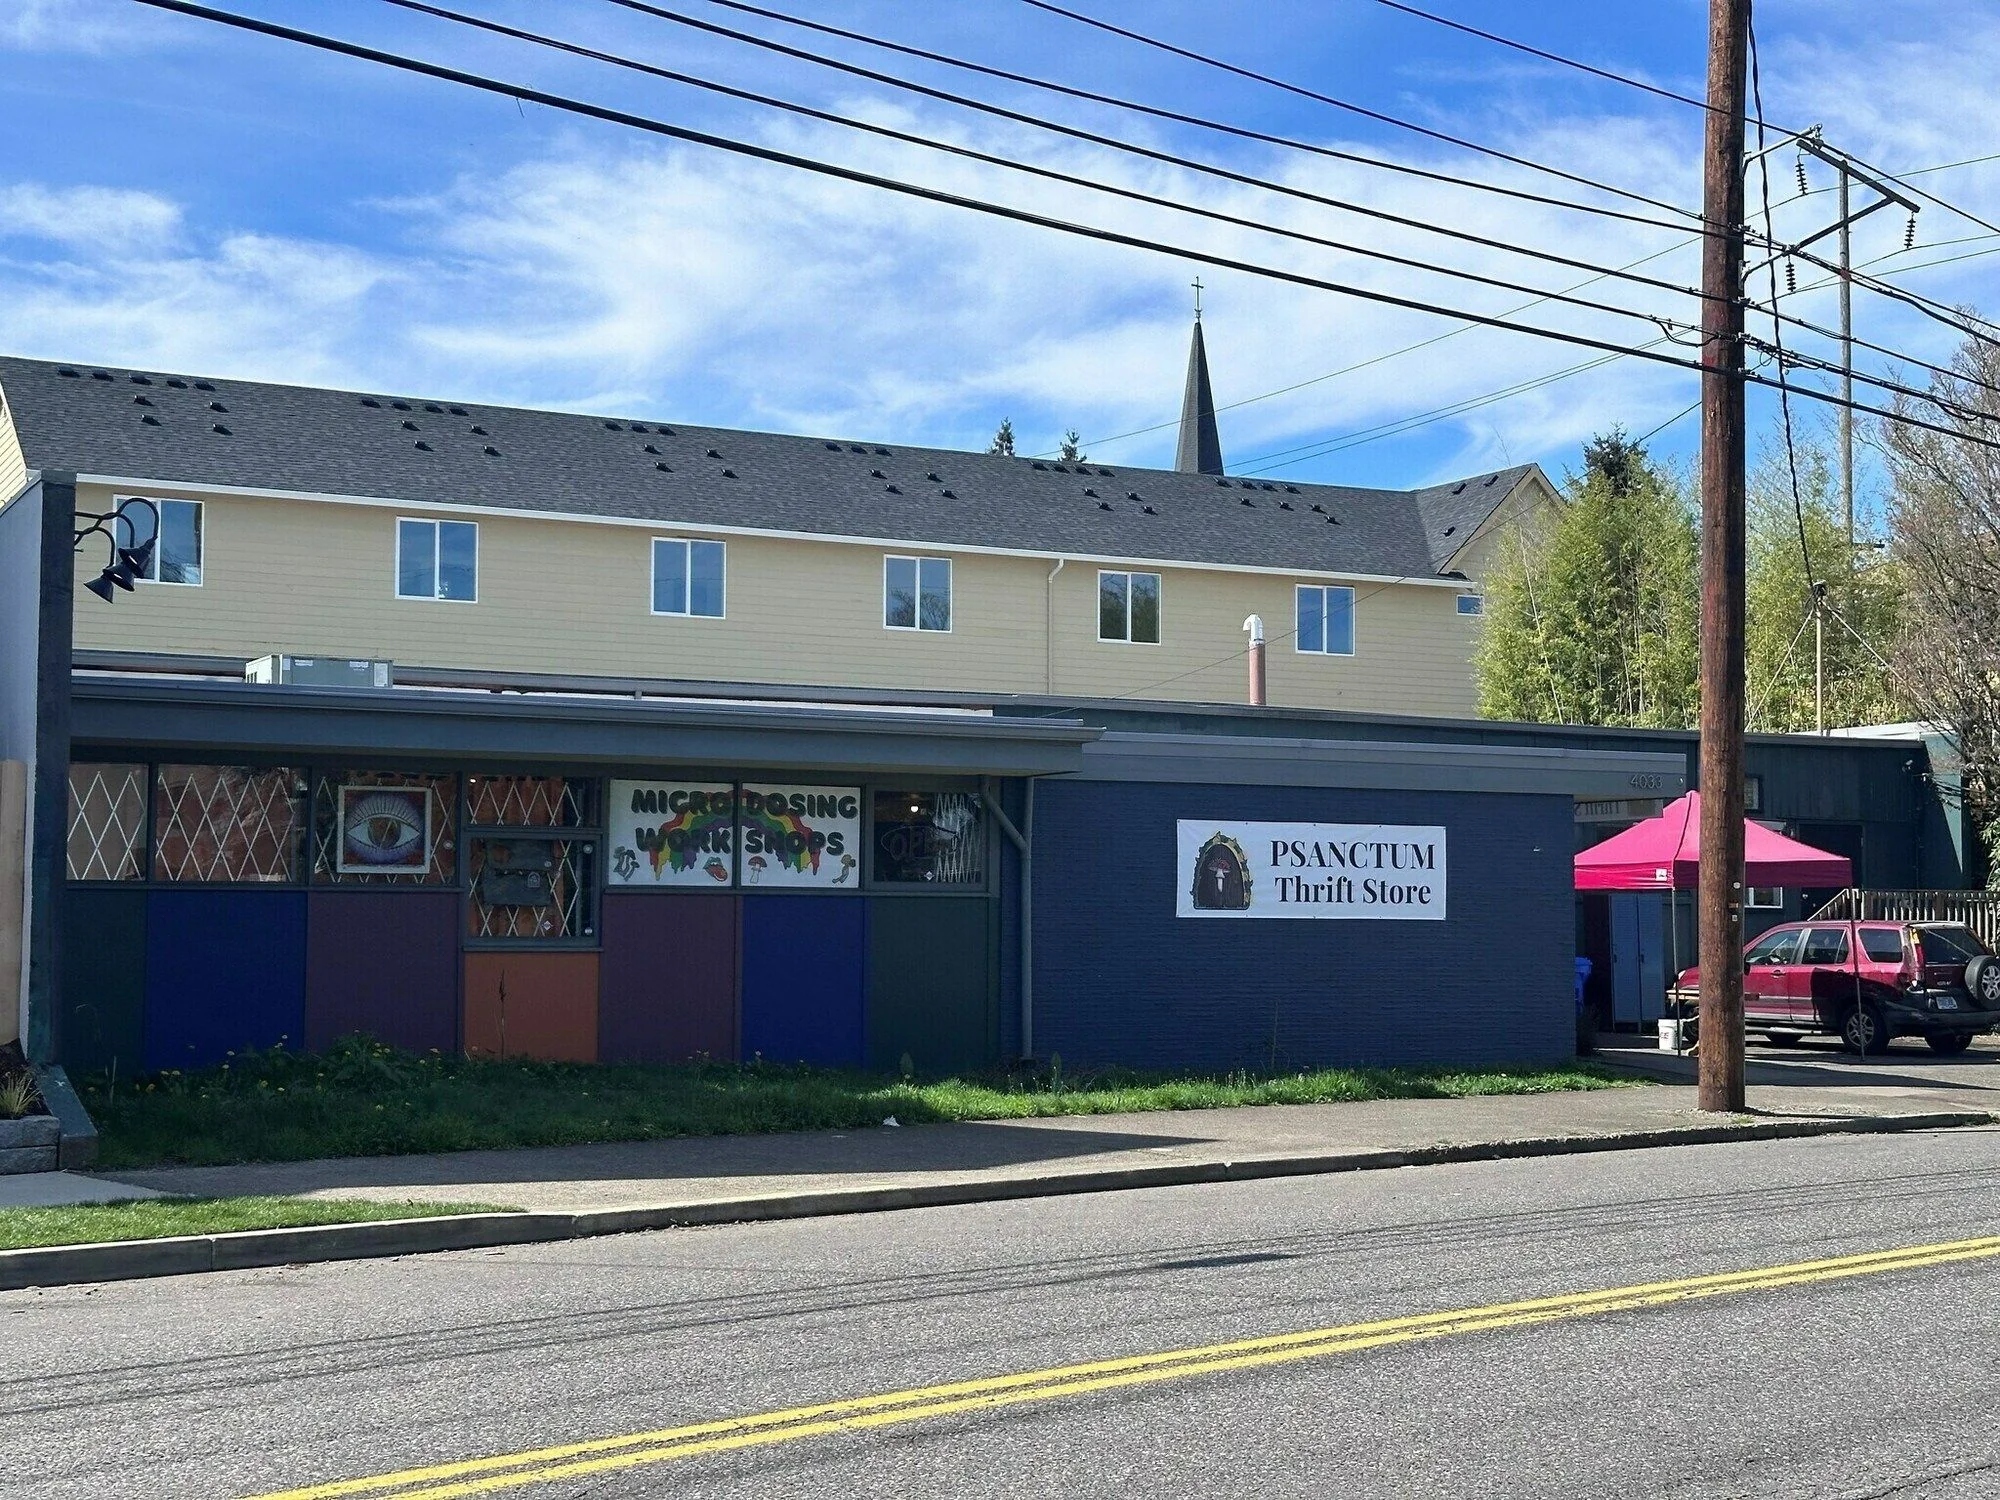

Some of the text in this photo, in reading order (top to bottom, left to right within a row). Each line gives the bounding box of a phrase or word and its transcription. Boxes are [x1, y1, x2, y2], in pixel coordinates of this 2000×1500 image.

[1630, 773, 1663, 789] 4033
[631, 788, 859, 820] MICRO DOSING
[635, 827, 845, 857] WORK SHOPS
[1270, 840, 1436, 870] PSANCTUM
[1274, 876, 1432, 905] Thrift Store
